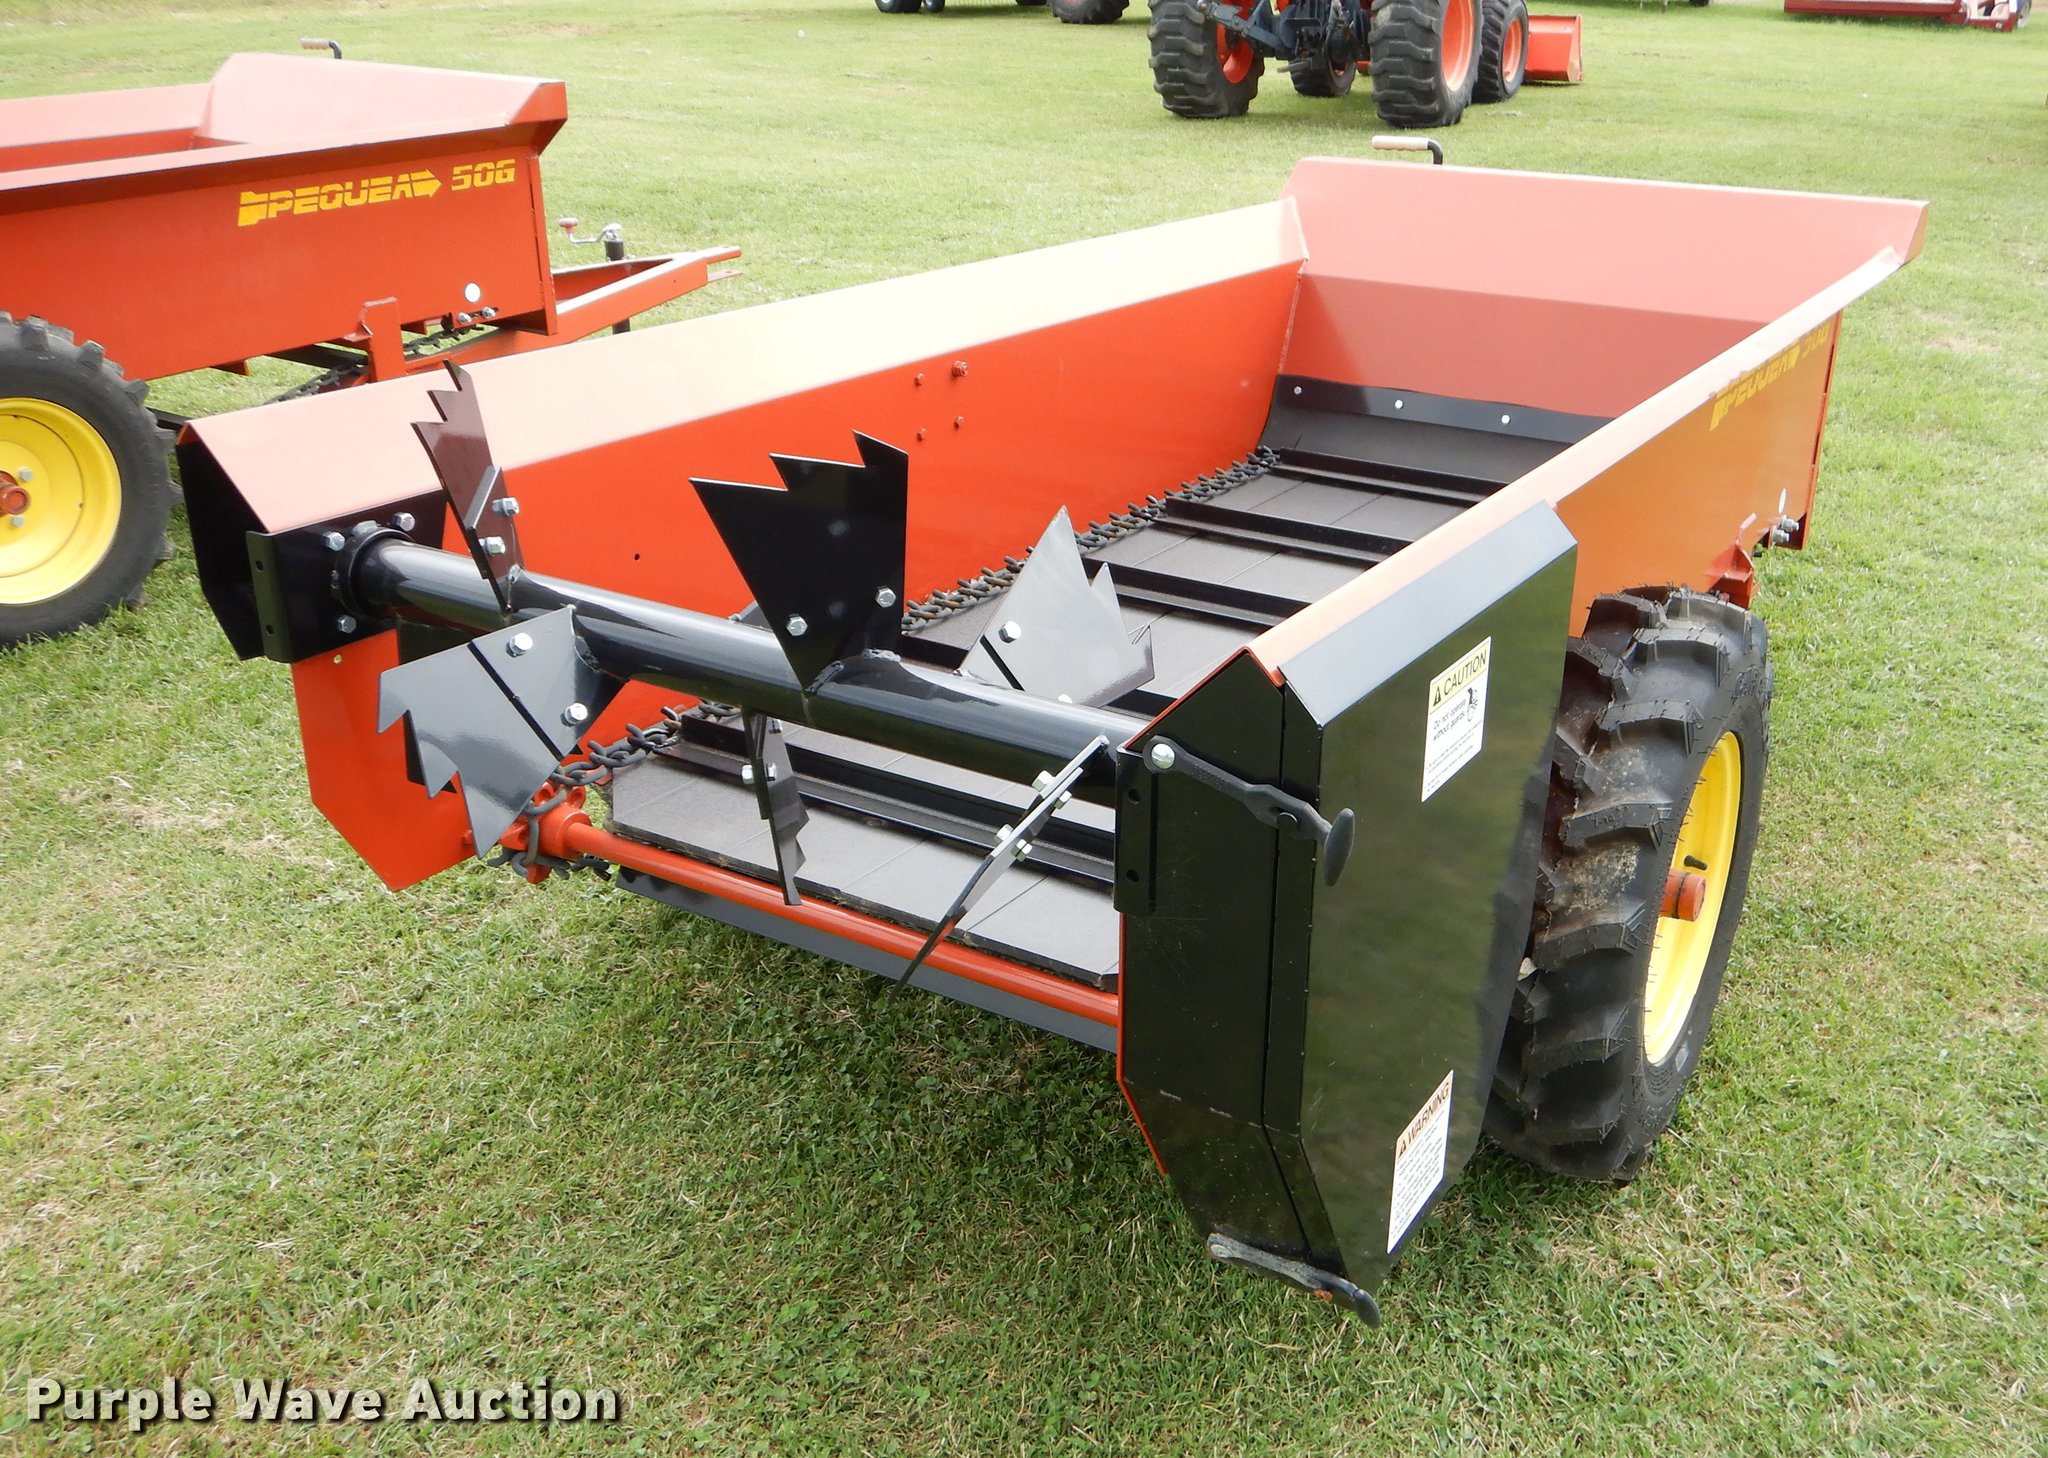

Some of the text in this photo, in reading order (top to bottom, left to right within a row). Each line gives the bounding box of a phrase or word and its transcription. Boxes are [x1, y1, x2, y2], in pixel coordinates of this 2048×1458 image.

[267, 158, 515, 219] PEQUEA 50G
[1443, 649, 1487, 696] CAUTION
[1407, 1082, 1450, 1143] WARNING
